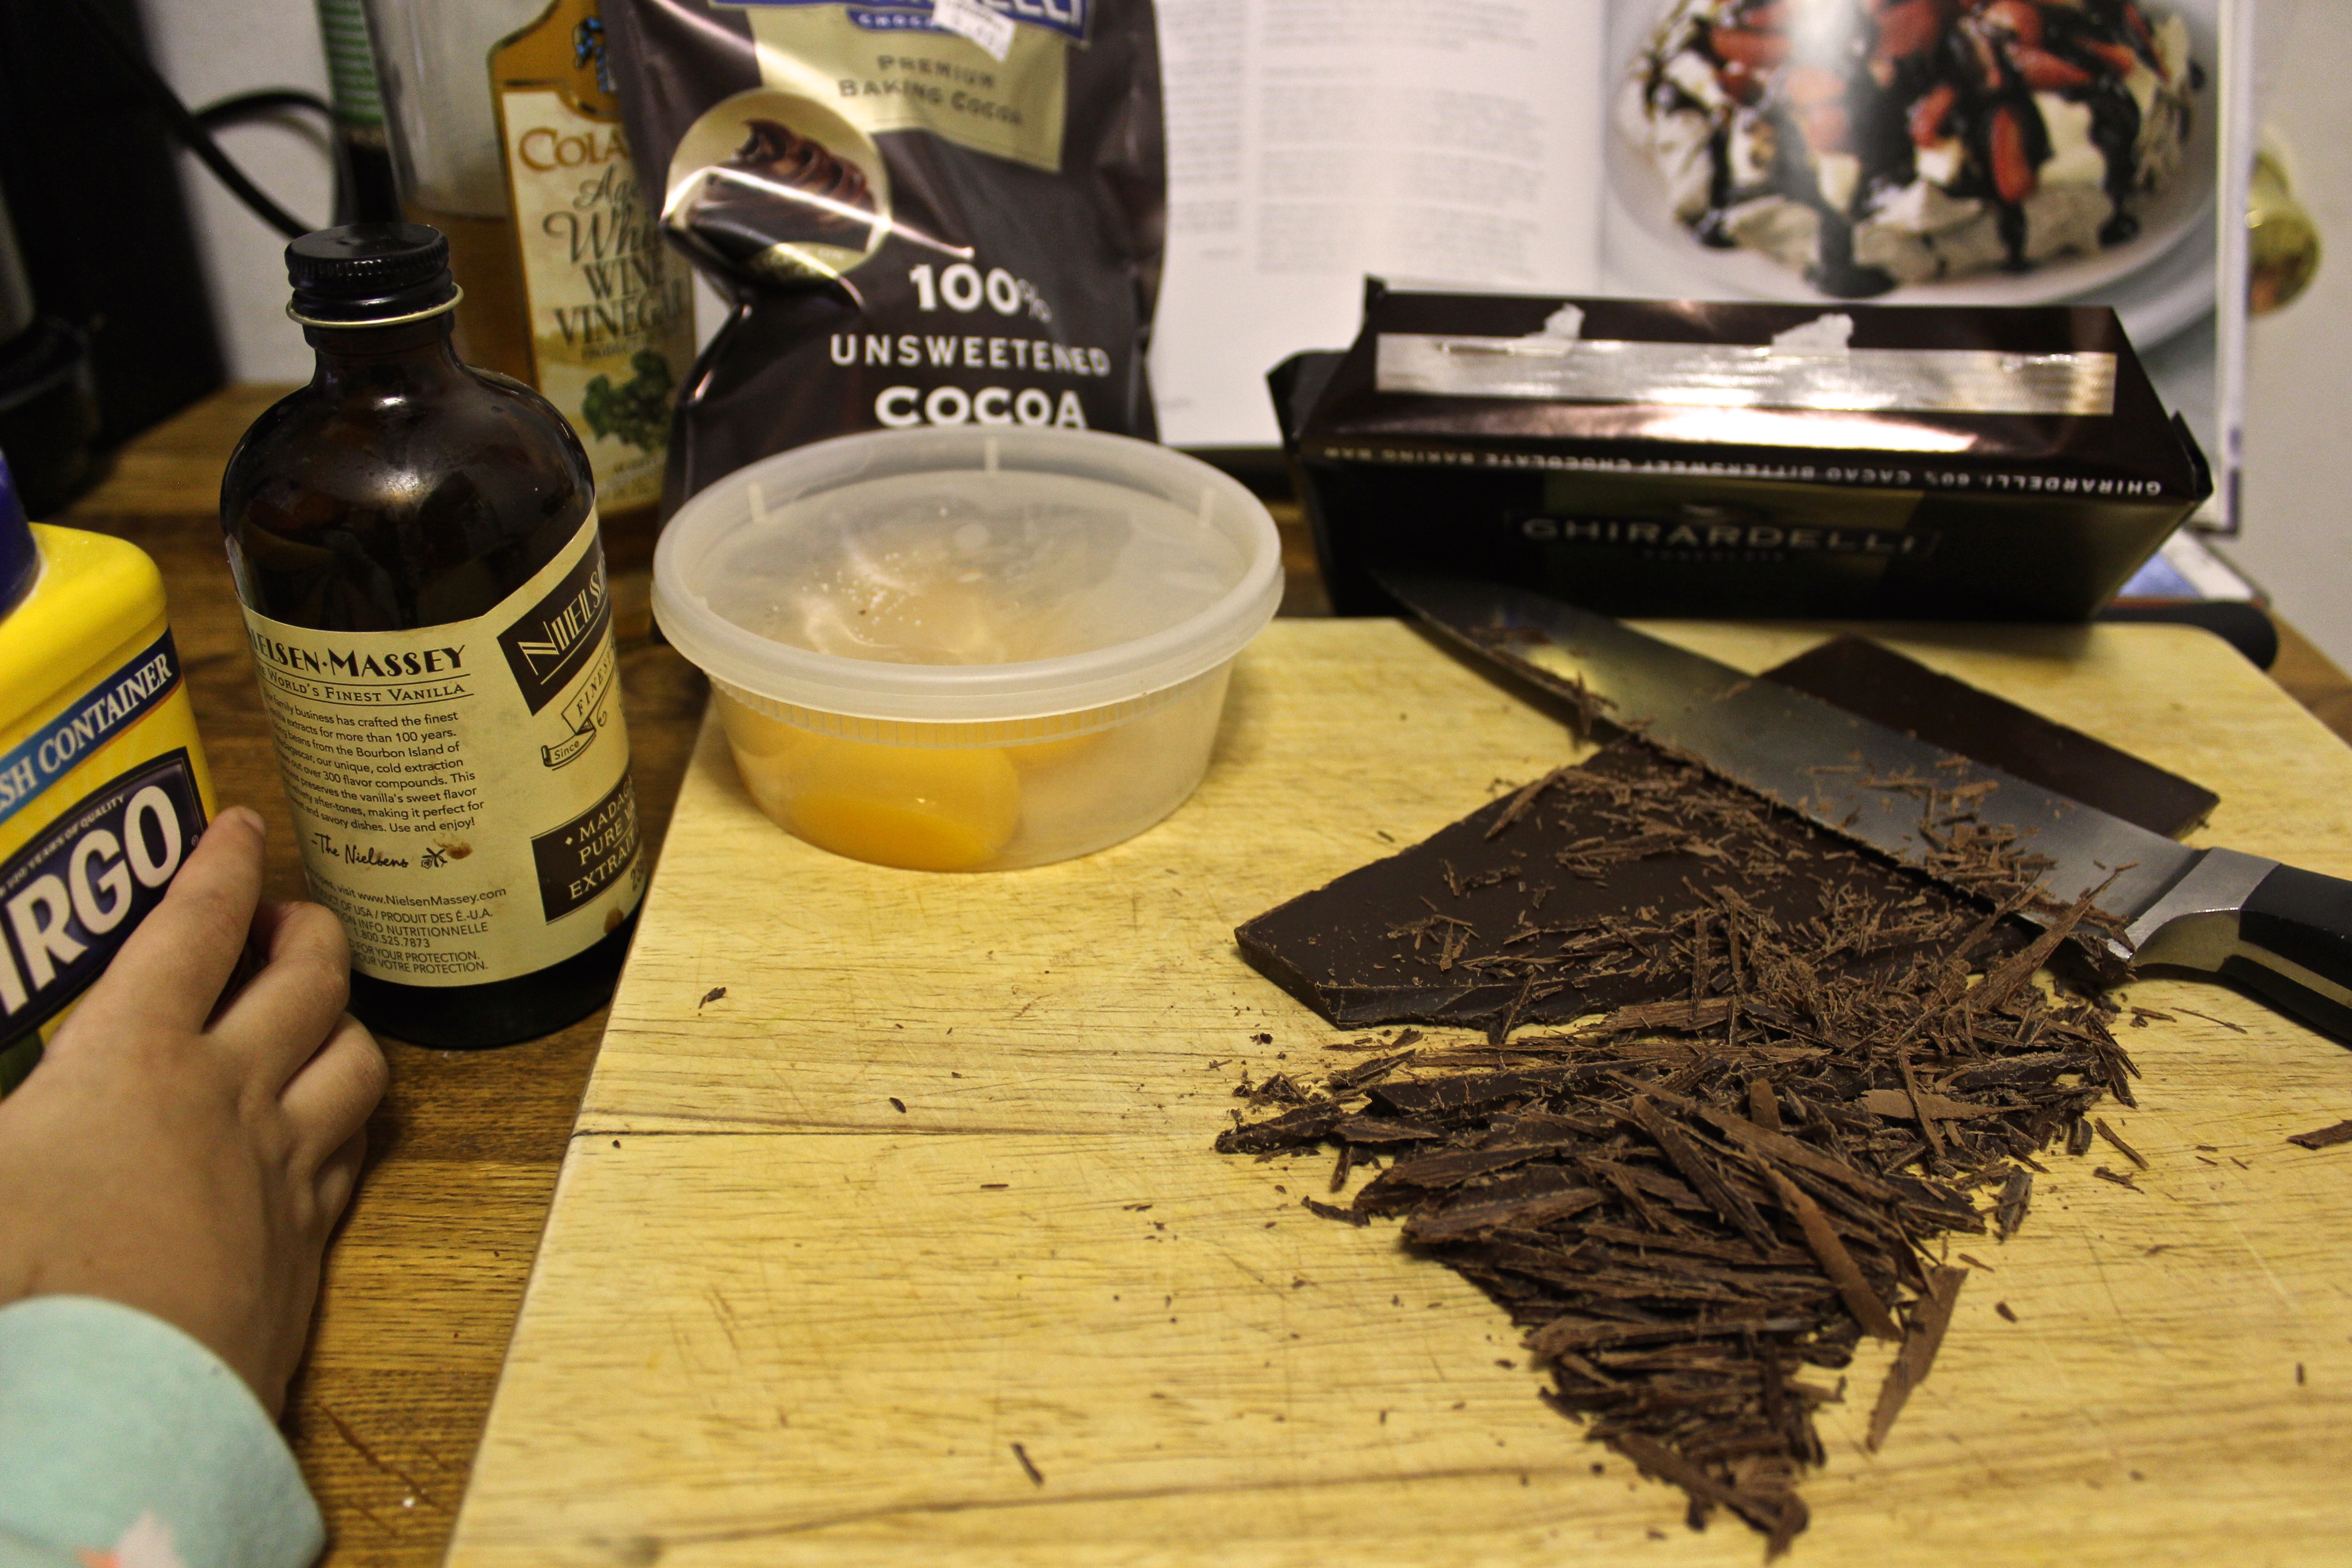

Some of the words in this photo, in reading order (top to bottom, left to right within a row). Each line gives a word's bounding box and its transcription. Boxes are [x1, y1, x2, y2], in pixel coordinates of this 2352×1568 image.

[877, 54, 995, 88] PREMIUM
[838, 79, 940, 104] BAKING
[951, 91, 1024, 125] COCOA
[909, 262, 1052, 323] 100%
[829, 333, 1111, 377] UNSWEETENED
[874, 385, 1088, 430] COCOA
[1523, 517, 1916, 555] GHIRARDELLI
[268, 667, 320, 697] WORLD'S
[324, 686, 382, 702] FINEST
[387, 683, 466, 702] VANILLA
[38, 653, 172, 773] CONTAINER
[294, 705, 334, 724] business
[336, 714, 355, 726] has
[358, 716, 398, 727] crafted
[401, 716, 422, 726] the
[425, 711, 459, 725] finest
[287, 716, 318, 735] extracts
[319, 726, 333, 739] for
[336, 731, 363, 742] more
[366, 732, 392, 743] than
[396, 731, 418, 742] 100
[421, 729, 457, 743] years.
[287, 730, 311, 747] beans
[312, 739, 334, 754] from
[336, 745, 353, 756] the
[356, 746, 406, 758] Bourbon
[409, 744, 444, 757] Island
[447, 740, 460, 752] of
[554, 740, 579, 760] Since
[304, 766, 322, 779] over
[323, 770, 341, 783] 300
[343, 774, 372, 788] flavor
[375, 775, 448, 791] compounds.
[449, 771, 476, 784] This
[317, 757, 332, 767] our
[334, 761, 373, 774] unique,
[377, 763, 401, 773] cold
[405, 759, 464, 773] extraction
[300, 777, 339, 798] preserves
[341, 789, 358, 801] the
[360, 793, 404, 804] vanilla's
[407, 792, 441, 803] sweet
[444, 787, 477, 800] flavor
[79, 794, 124, 828] QUALITY
[314, 795, 366, 818] after-tones,
[368, 807, 408, 820] making
[412, 808, 420, 818] it
[423, 804, 465, 820] perfect
[467, 800, 485, 812] for
[320, 813, 349, 829] savory
[351, 819, 387, 833] dishes.
[389, 823, 411, 833] Use
[414, 821, 436, 832] and
[439, 816, 475, 832] enjoy!
[578, 817, 623, 858] PURE
[345, 843, 409, 868] Nielsens
[337, 884, 356, 898] visit
[357, 888, 507, 907] www.NielsenMassey.com
[353, 904, 373, 919] USA
[381, 910, 427, 924] PRODUIT
[431, 912, 453, 924] DES
[353, 926, 430, 948] 1.800.525.7873
[358, 917, 383, 934] INFO
[386, 921, 489, 938] NUTRITIONNELLE
[374, 947, 403, 961] YOUR
[405, 951, 480, 964] PROTECTION.
[377, 958, 411, 973] VOTRE
[413, 960, 488, 974] PROTECTION.
